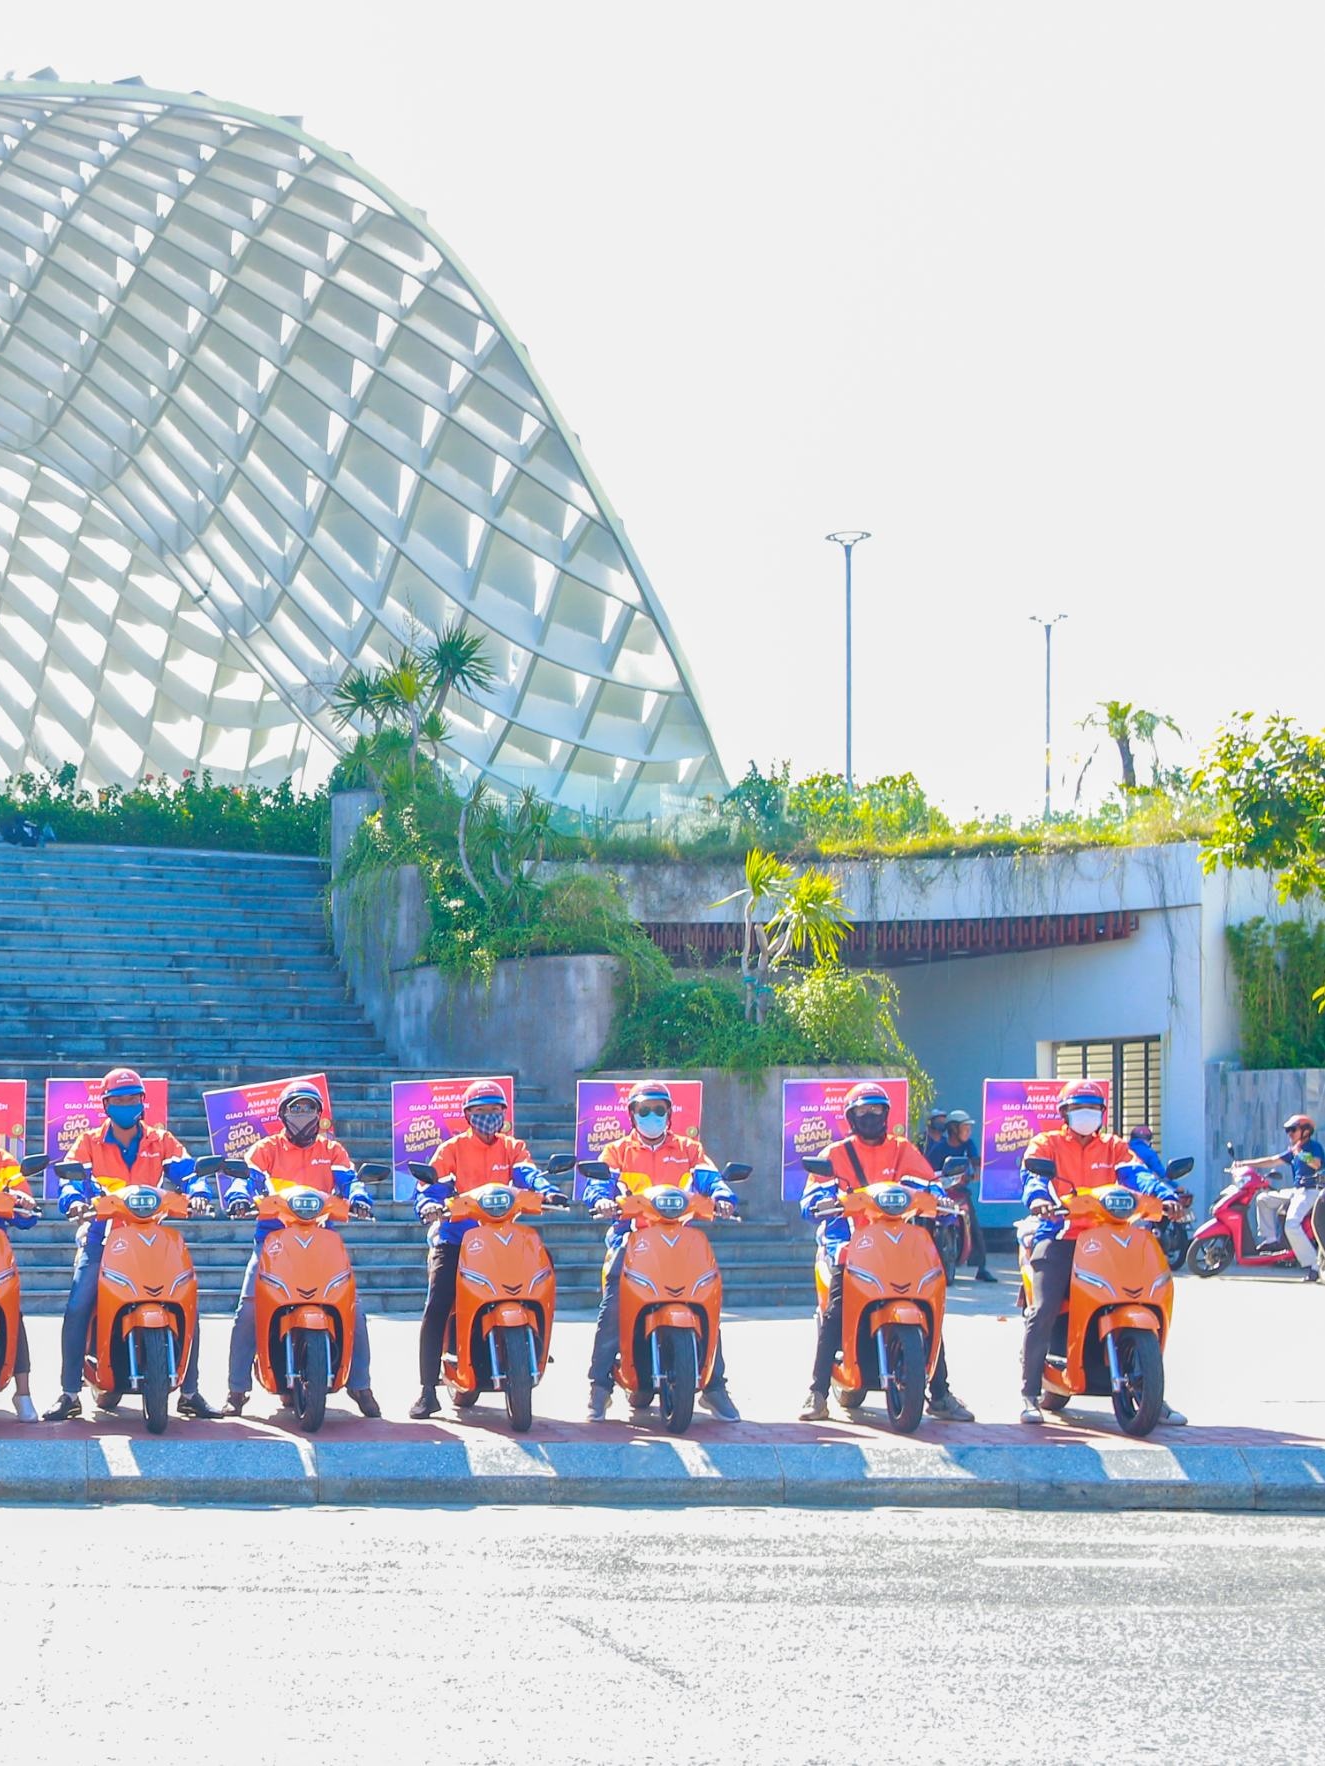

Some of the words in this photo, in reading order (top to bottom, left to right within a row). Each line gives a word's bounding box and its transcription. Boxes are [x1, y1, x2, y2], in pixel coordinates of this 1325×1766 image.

[225, 1111, 243, 1120] GIAO
[63, 1119, 90, 1131] GIAO
[409, 1119, 435, 1132] GIAO
[593, 1121, 620, 1132] GIAO
[800, 1121, 826, 1133] GIAO
[1001, 1119, 1028, 1132] GIAO
[228, 1126, 254, 1141] GIAO
[404, 1128, 441, 1144] NHANH
[587, 1129, 625, 1142] NHANH
[794, 1129, 832, 1144] NHANH
[995, 1129, 1034, 1143] NHANH
[224, 1133, 261, 1152] NHANH
